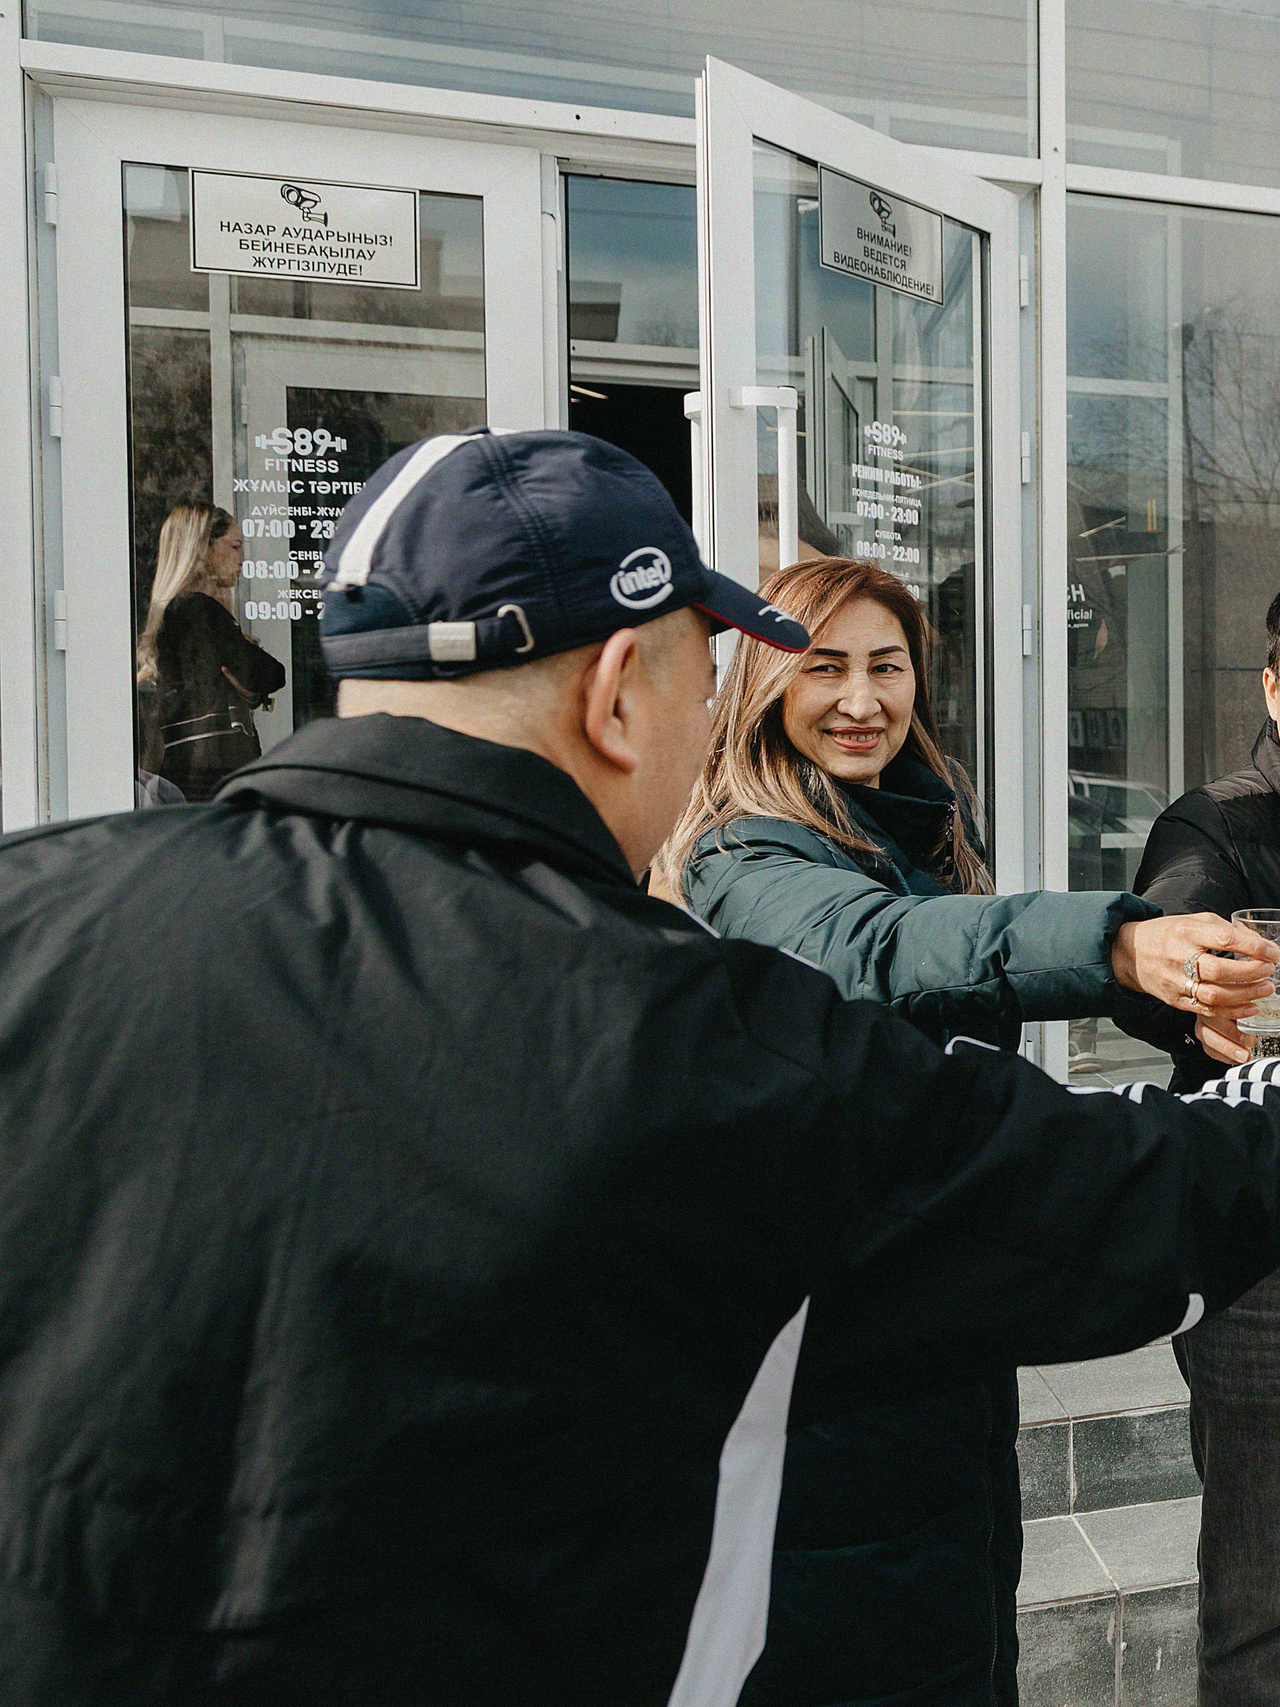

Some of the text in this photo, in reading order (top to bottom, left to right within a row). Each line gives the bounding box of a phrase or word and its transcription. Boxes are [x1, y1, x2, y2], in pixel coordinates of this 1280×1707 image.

[219, 221, 277, 237] НАЗАР
[239, 238, 376, 261] БЕЙНЕБАҚЫЛАУ
[856, 227, 912, 258] ВНИМАНИЕ!
[252, 255, 363, 277] ЖҮРГІЗІЛУДЕ!
[863, 245, 907, 271] ВЕДЕТСЯ
[833, 251, 935, 297] ВИДЕОНАБЛЮДЕНИЕ!
[268, 427, 335, 457] S89
[868, 421, 903, 447] S89
[868, 444, 904, 462] FITNESS
[264, 458, 340, 474] FITNESS
[851, 463, 922, 490] РЕЖИМ РАБОТЫ:
[233, 478, 305, 494] ЖҰМЫС
[251, 504, 345, 518] ДҮЙСЕНБІ-ЖҰМ
[856, 500, 884, 520] 07:00
[890, 506, 919, 526] 23:00
[242, 518, 296, 539] 07:00
[875, 529, 902, 542] СУББОТА
[288, 550, 323, 561] СЕНБІ
[856, 540, 886, 559] 08:00
[892, 545, 920, 564] 22:00
[242, 560, 299, 580] 08:00
[313, 561, 326, 580] 2
[617, 557, 668, 596] intel
[244, 601, 302, 621] 09:00
[316, 601, 326, 621] 2
